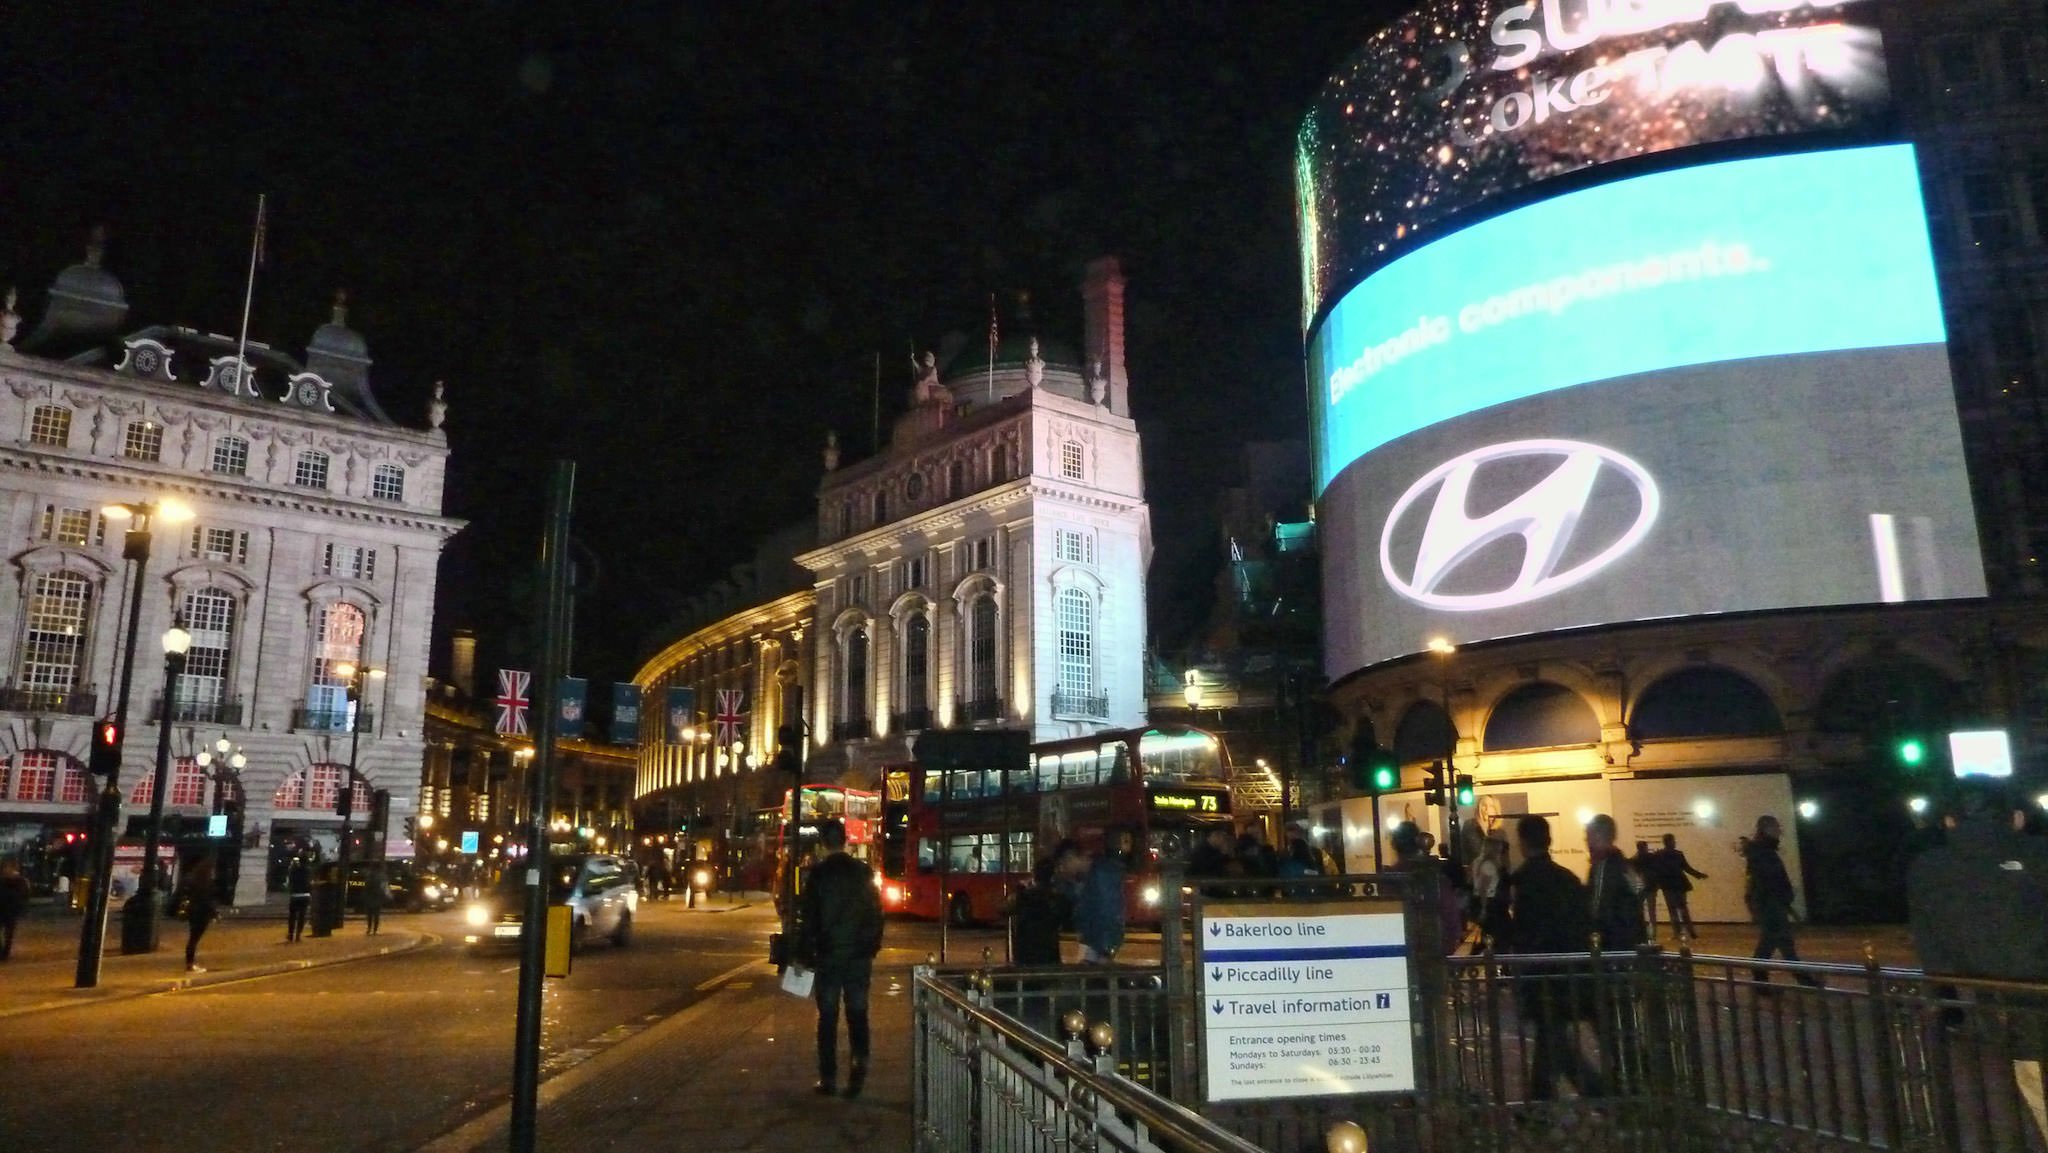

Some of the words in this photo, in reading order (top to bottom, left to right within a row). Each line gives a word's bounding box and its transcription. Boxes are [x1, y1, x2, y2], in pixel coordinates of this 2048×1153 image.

[1330, 316, 1450, 406] Electronic
[1459, 240, 1771, 333] components.
[1201, 795, 1217, 811] 73
[1225, 922, 1293, 938] Bakerloo
[1298, 922, 1326, 936] line
[1227, 966, 1301, 983] Piccadilly
[1306, 966, 1334, 980] line
[1229, 1000, 1276, 1015] Travel
[1282, 997, 1371, 1013] information
[1229, 1034, 1273, 1045] Entrance
[1277, 1033, 1316, 1046] opening
[1319, 1032, 1346, 1042] times
[1230, 1050, 1266, 1060] Mondays
[1269, 1049, 1279, 1058] to
